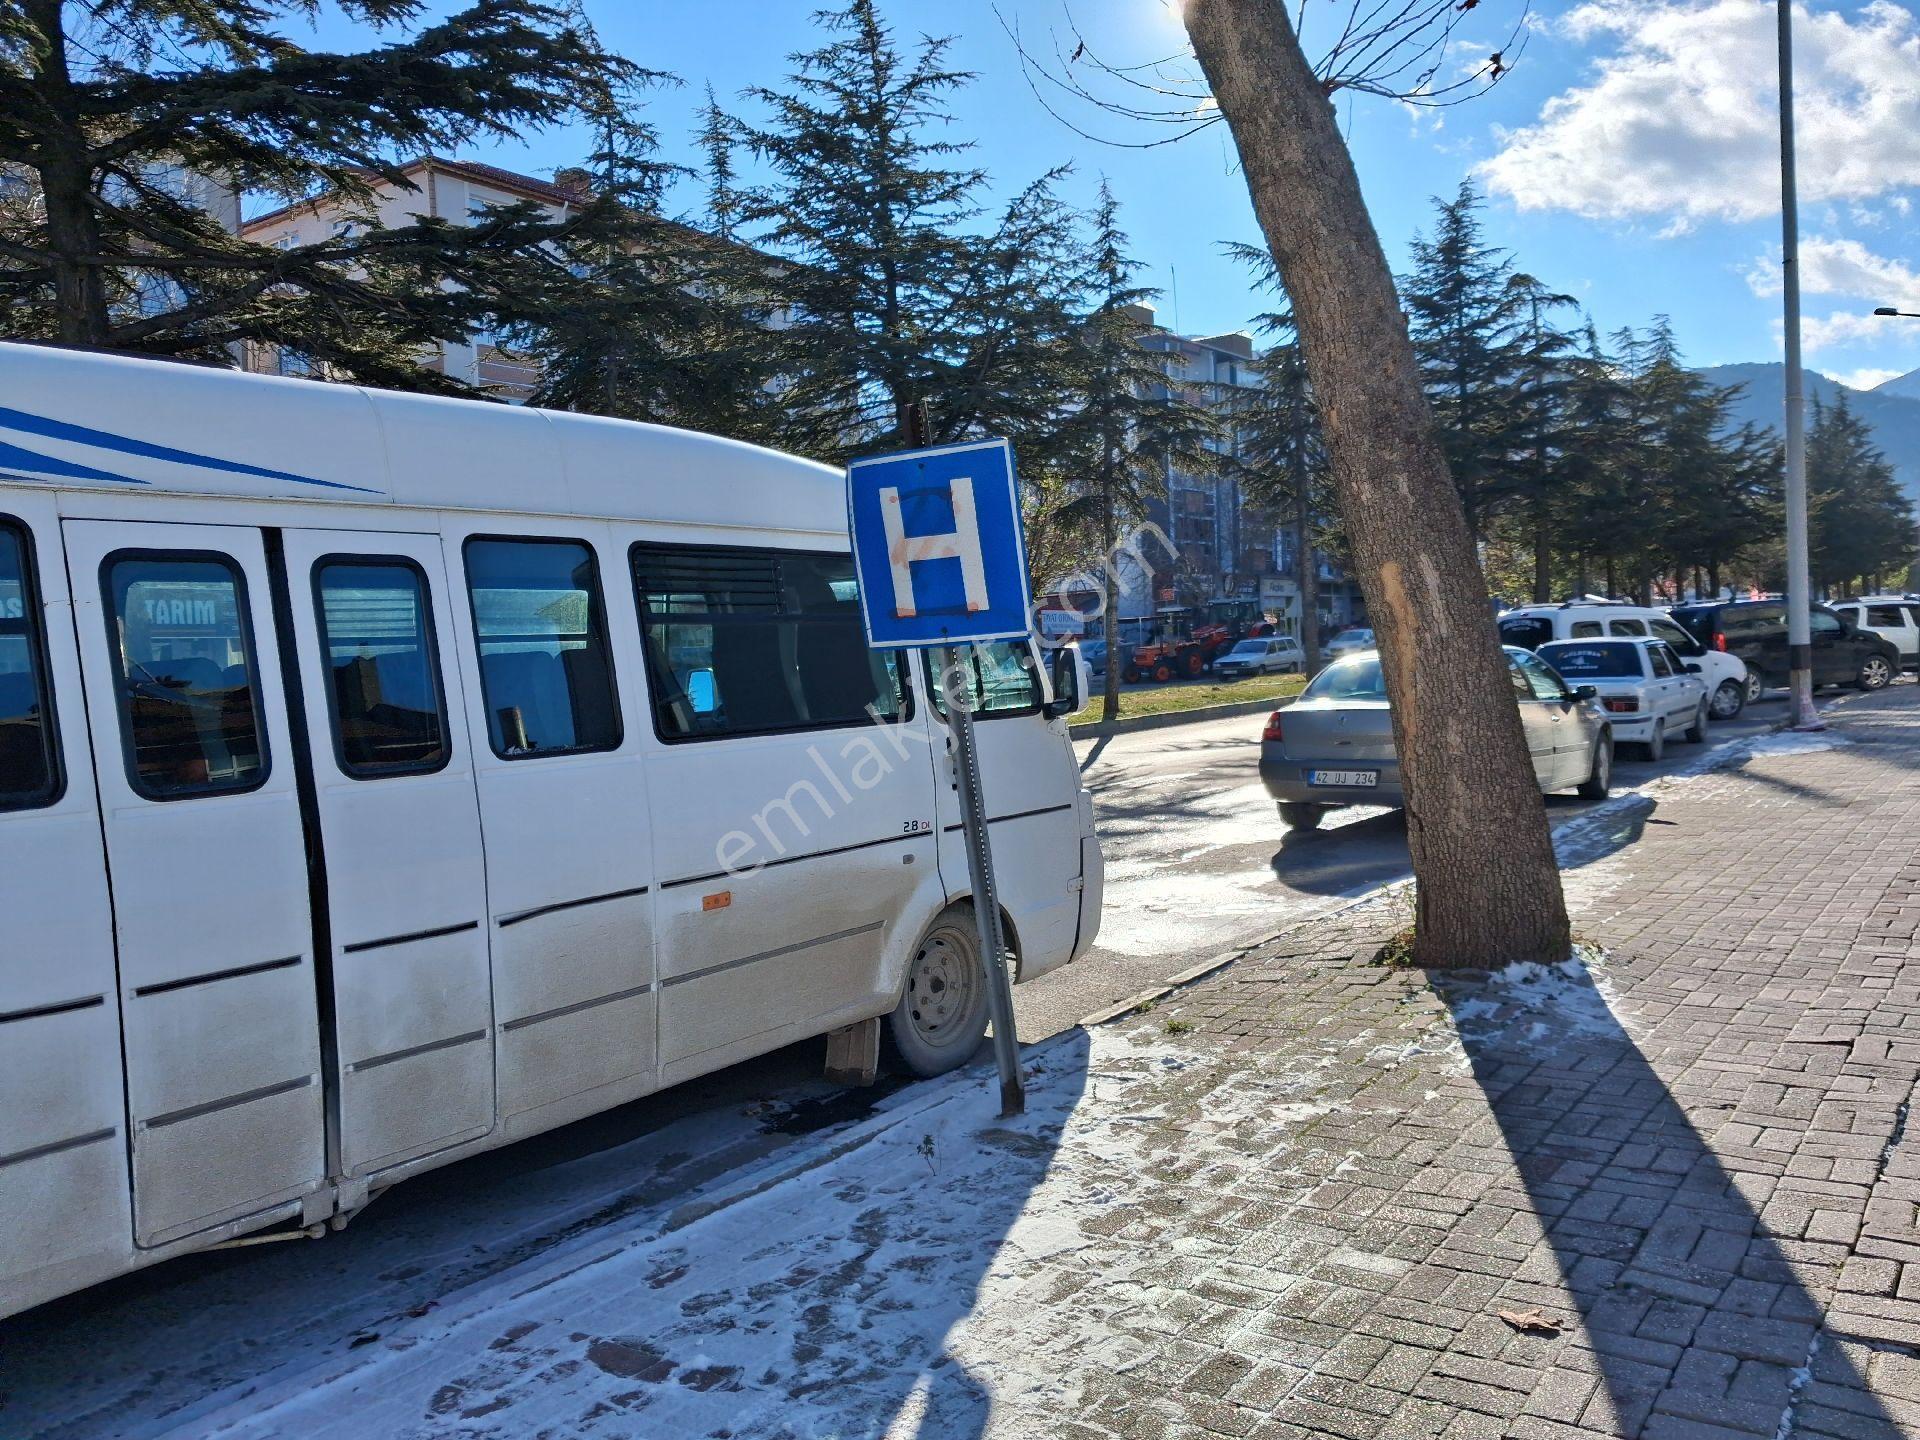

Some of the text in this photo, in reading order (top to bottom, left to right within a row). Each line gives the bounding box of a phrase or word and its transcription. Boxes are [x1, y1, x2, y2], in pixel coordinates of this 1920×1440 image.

[879, 477, 989, 618] H
[146, 599, 215, 625] TARIM
[1316, 772, 1328, 784] 42
[1355, 773, 1374, 785] 234
